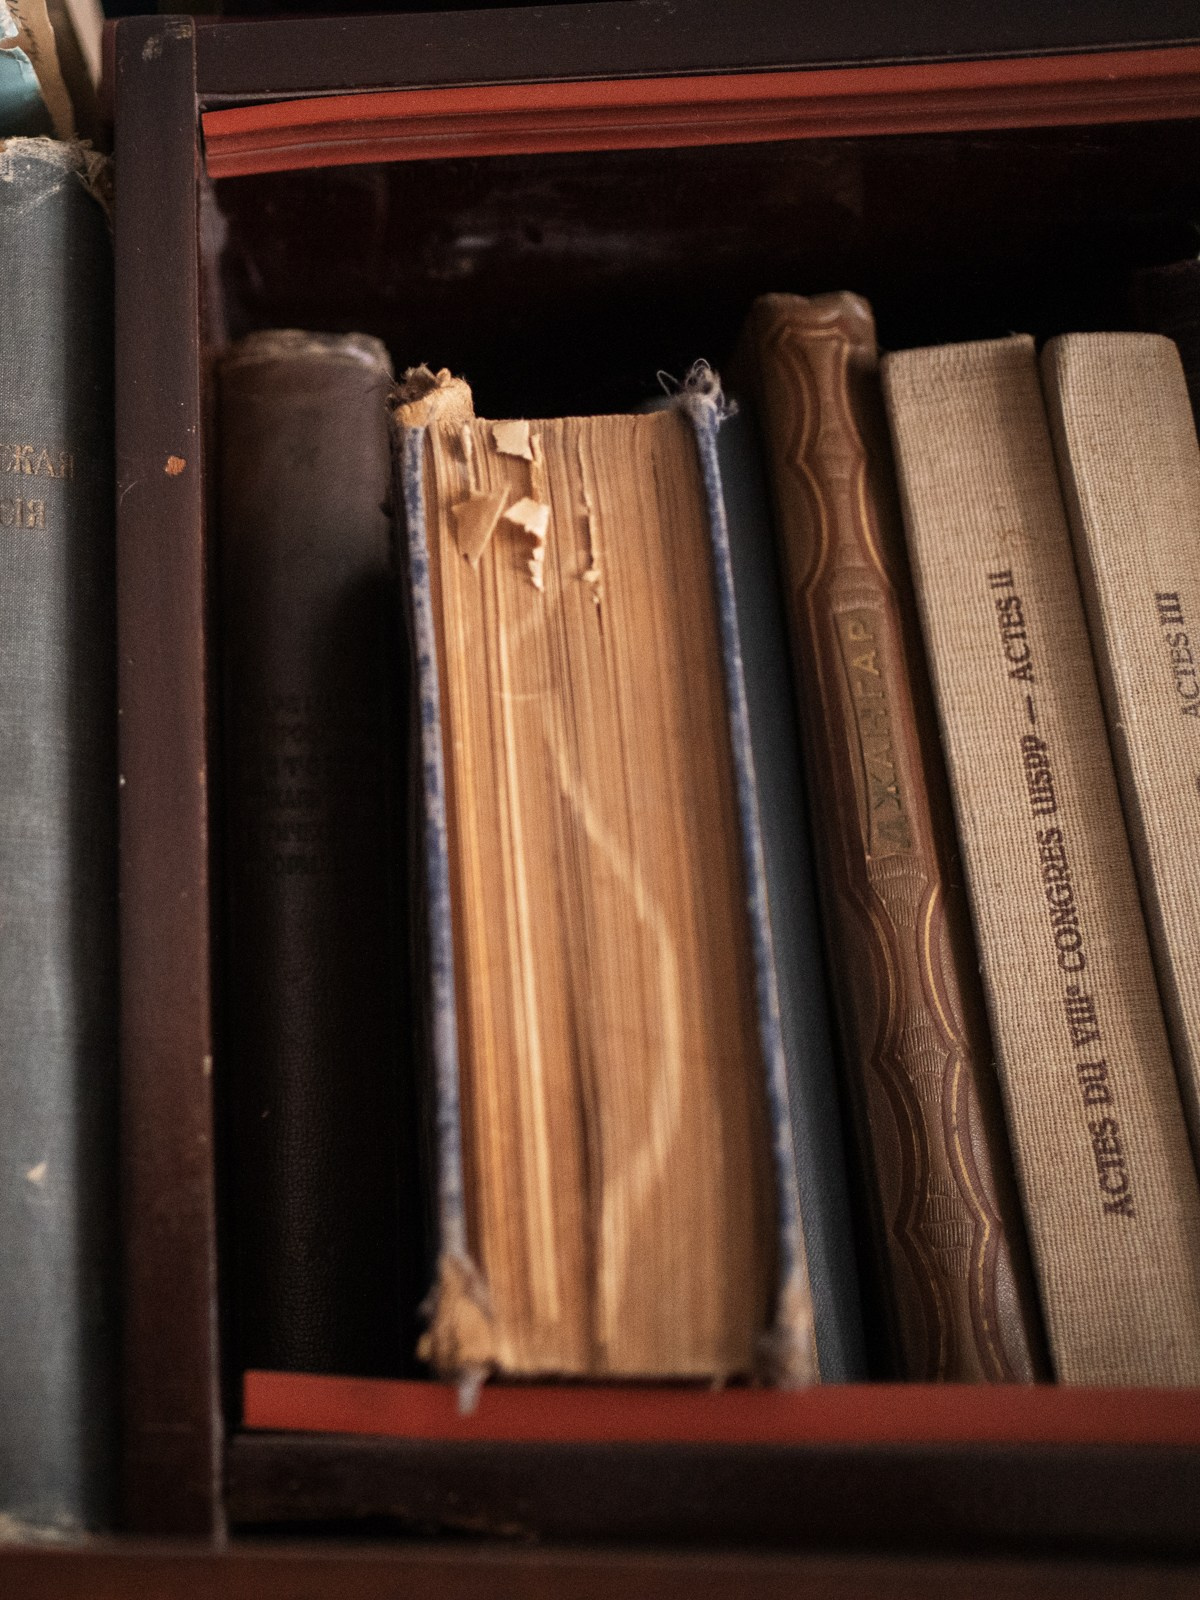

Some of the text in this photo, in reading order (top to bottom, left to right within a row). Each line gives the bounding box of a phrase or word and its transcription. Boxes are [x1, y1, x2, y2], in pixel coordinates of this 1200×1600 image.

[988, 570, 1014, 590] II
[1155, 591, 1185, 626] III
[995, 595, 1034, 684] ACTES
[1076, 1059, 1114, 1108] DU
[1088, 1117, 1137, 1219] ACTES
